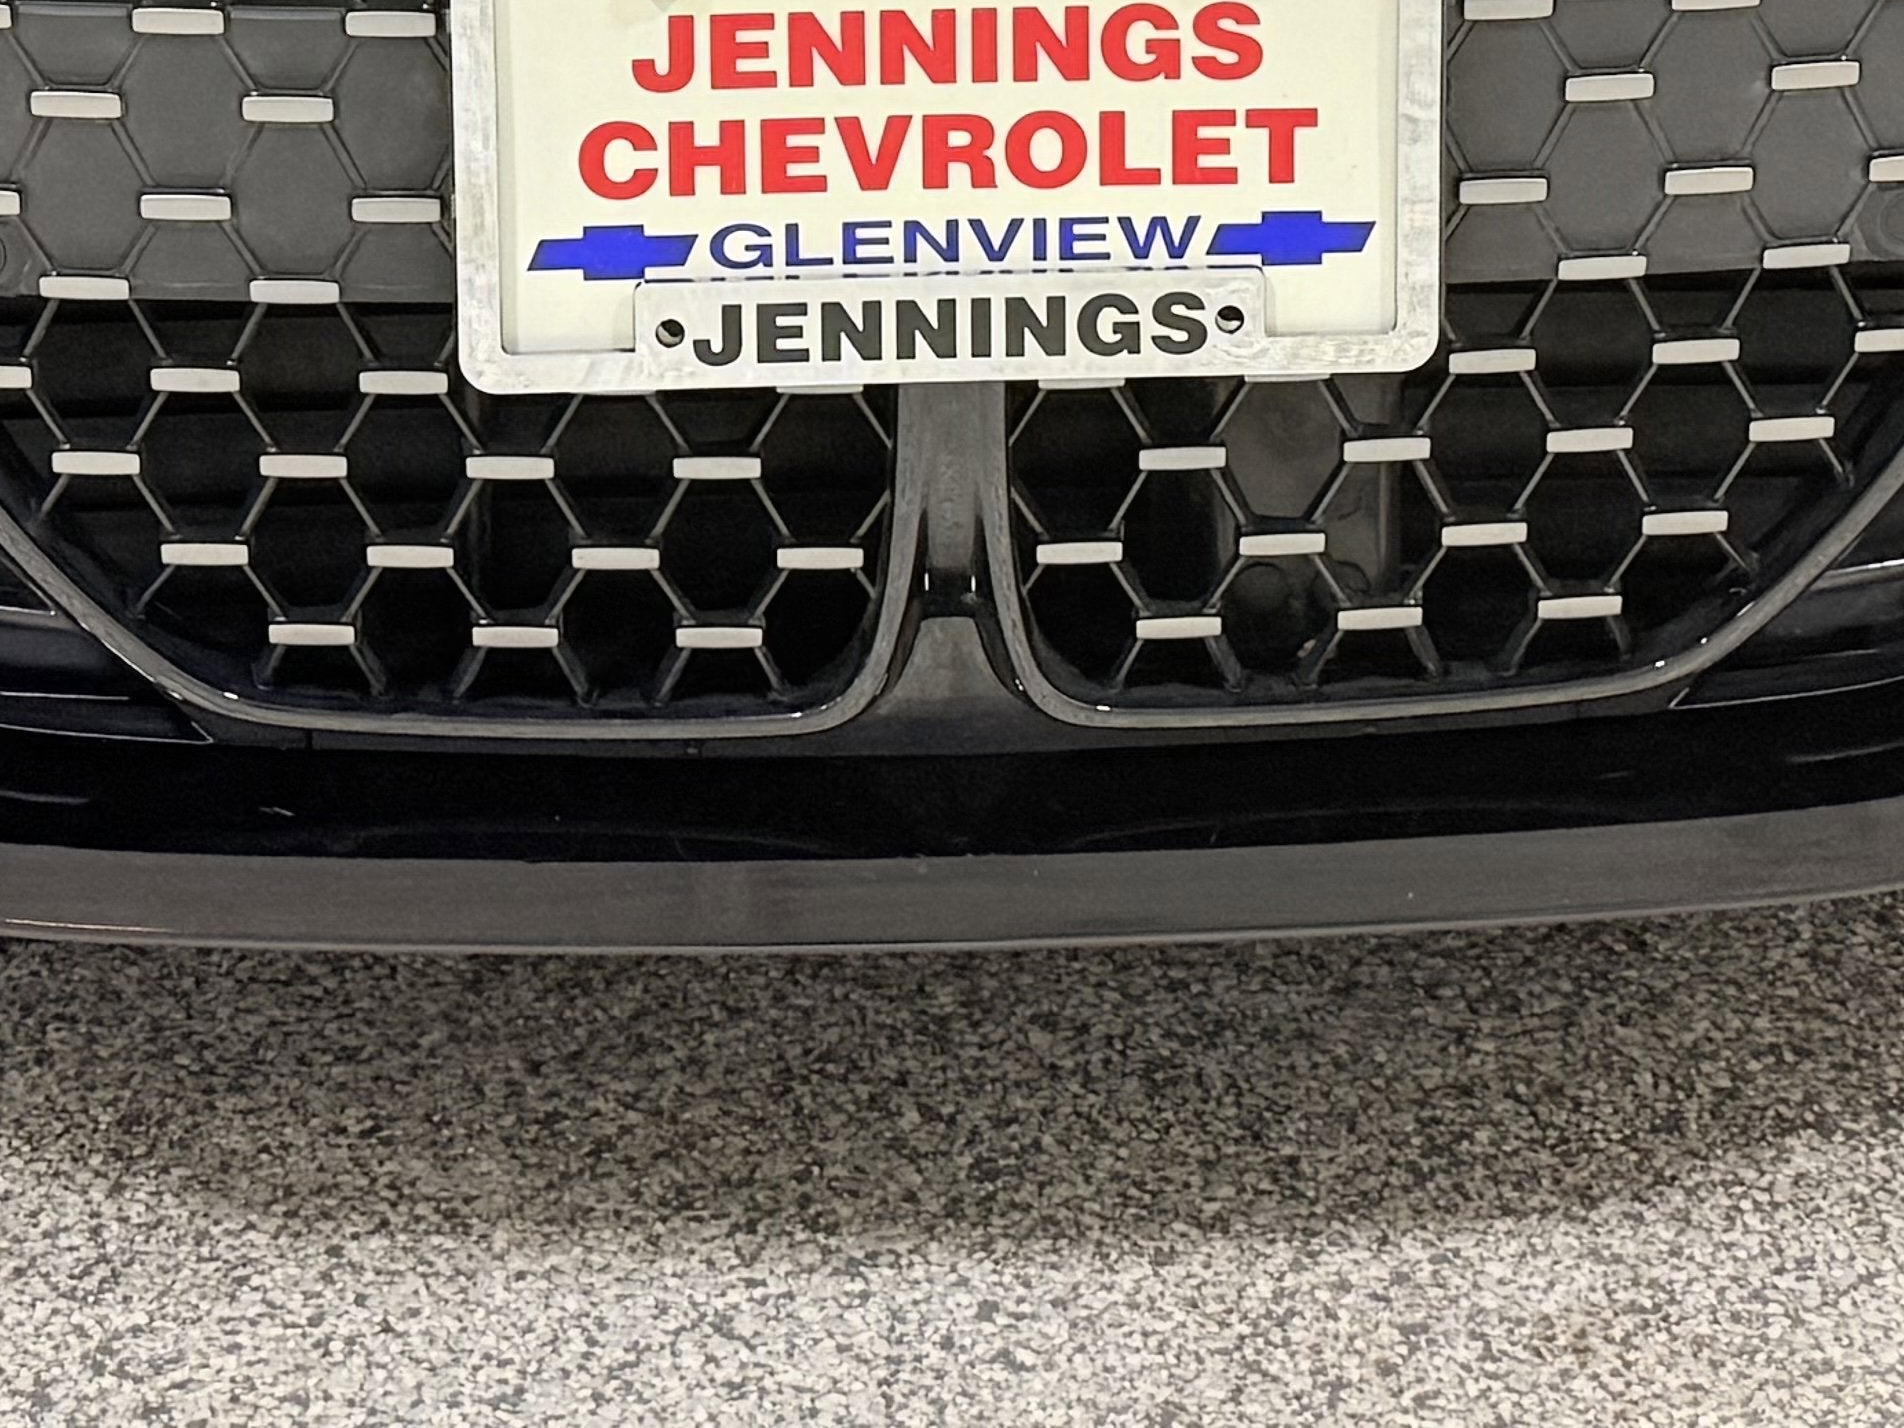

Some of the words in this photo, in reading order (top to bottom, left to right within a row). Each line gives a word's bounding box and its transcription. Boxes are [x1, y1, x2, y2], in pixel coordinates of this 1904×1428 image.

[631, 1, 1264, 93] JENNINGS
[577, 106, 1320, 200] CHEVROLET
[708, 215, 1202, 269] GLENVIEW
[692, 291, 1208, 367] JENNINGS
